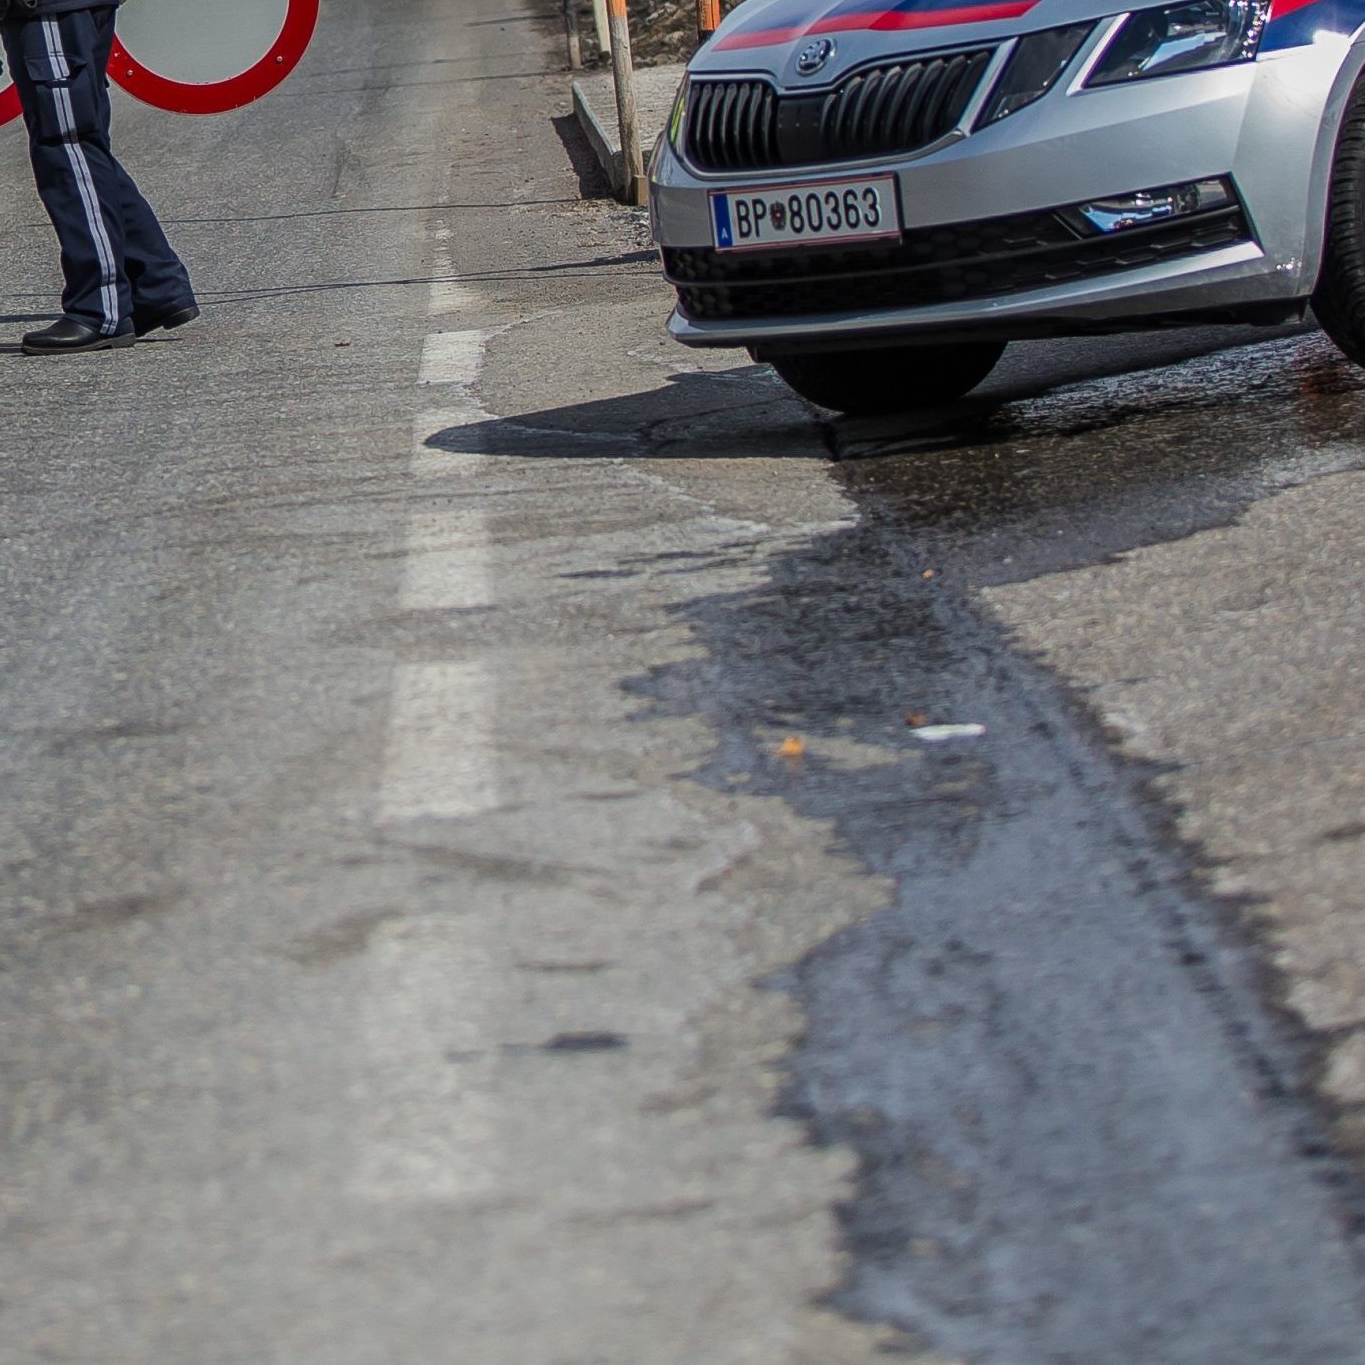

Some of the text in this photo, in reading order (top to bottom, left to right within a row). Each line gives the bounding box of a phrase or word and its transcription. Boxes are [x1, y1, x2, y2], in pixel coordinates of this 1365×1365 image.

[735, 187, 883, 239] BP 80363
[721, 228, 730, 240] A
